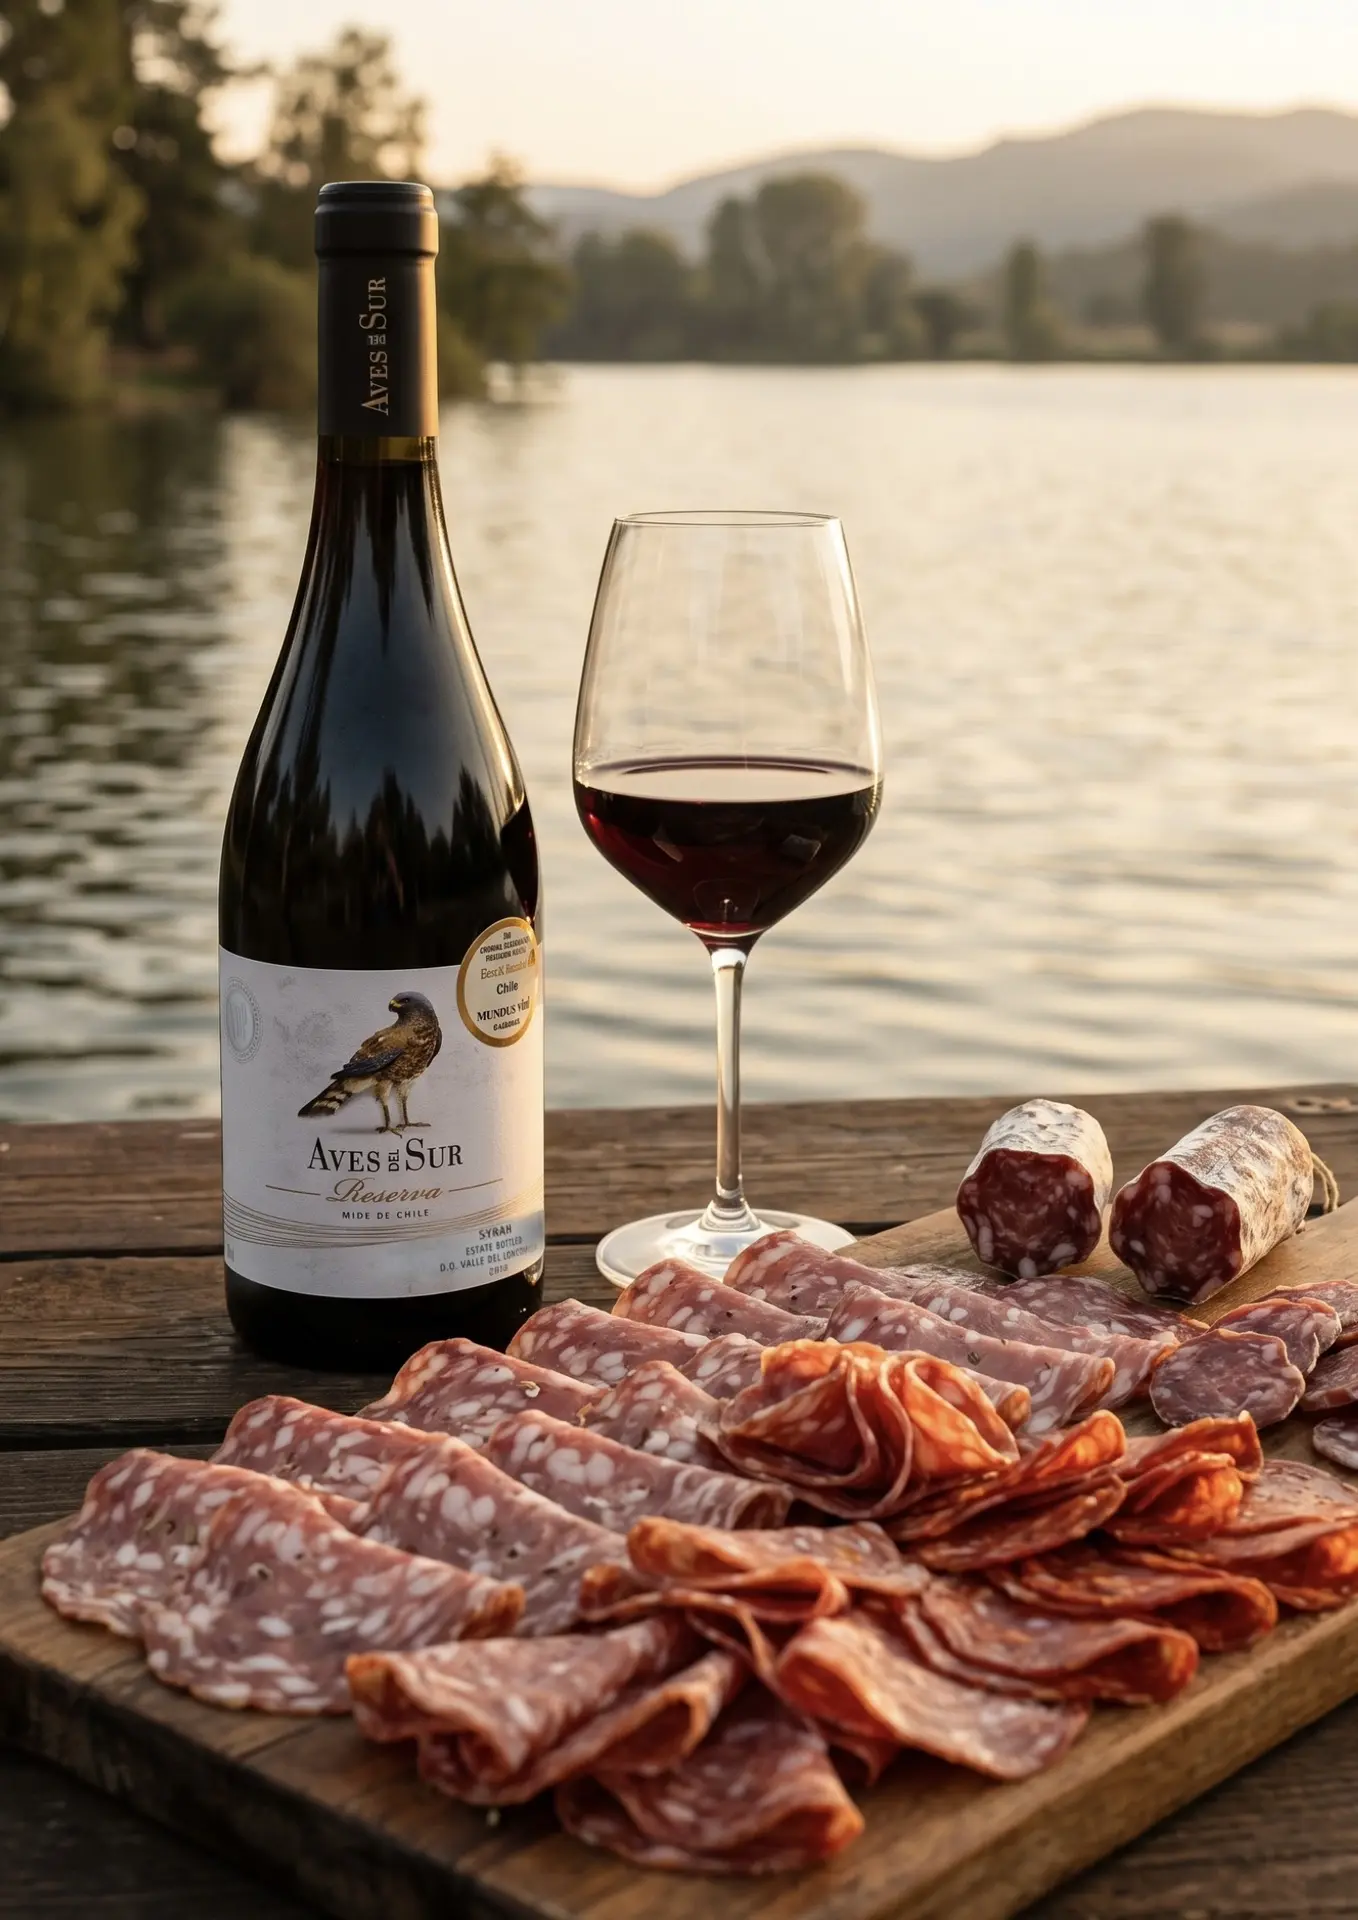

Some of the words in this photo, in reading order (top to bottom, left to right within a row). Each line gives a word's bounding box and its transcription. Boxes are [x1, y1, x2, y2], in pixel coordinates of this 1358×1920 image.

[359, 277, 387, 330] SUR
[361, 350, 389, 416] AVES
[496, 981, 519, 995] Chile
[476, 1004, 516, 1021] MUNDUS
[307, 1136, 381, 1173] AVES
[388, 1149, 400, 1172] DEL
[405, 1137, 463, 1172] SUR
[325, 1177, 443, 1203] Reserva
[342, 1211, 370, 1220] MIDE
[377, 1212, 390, 1220] DE
[396, 1209, 429, 1219] CHILE
[478, 1224, 512, 1241] SYRAH
[465, 1242, 493, 1256] ESTATE
[460, 1256, 485, 1269] VALLE
[487, 1253, 501, 1264] DEL
